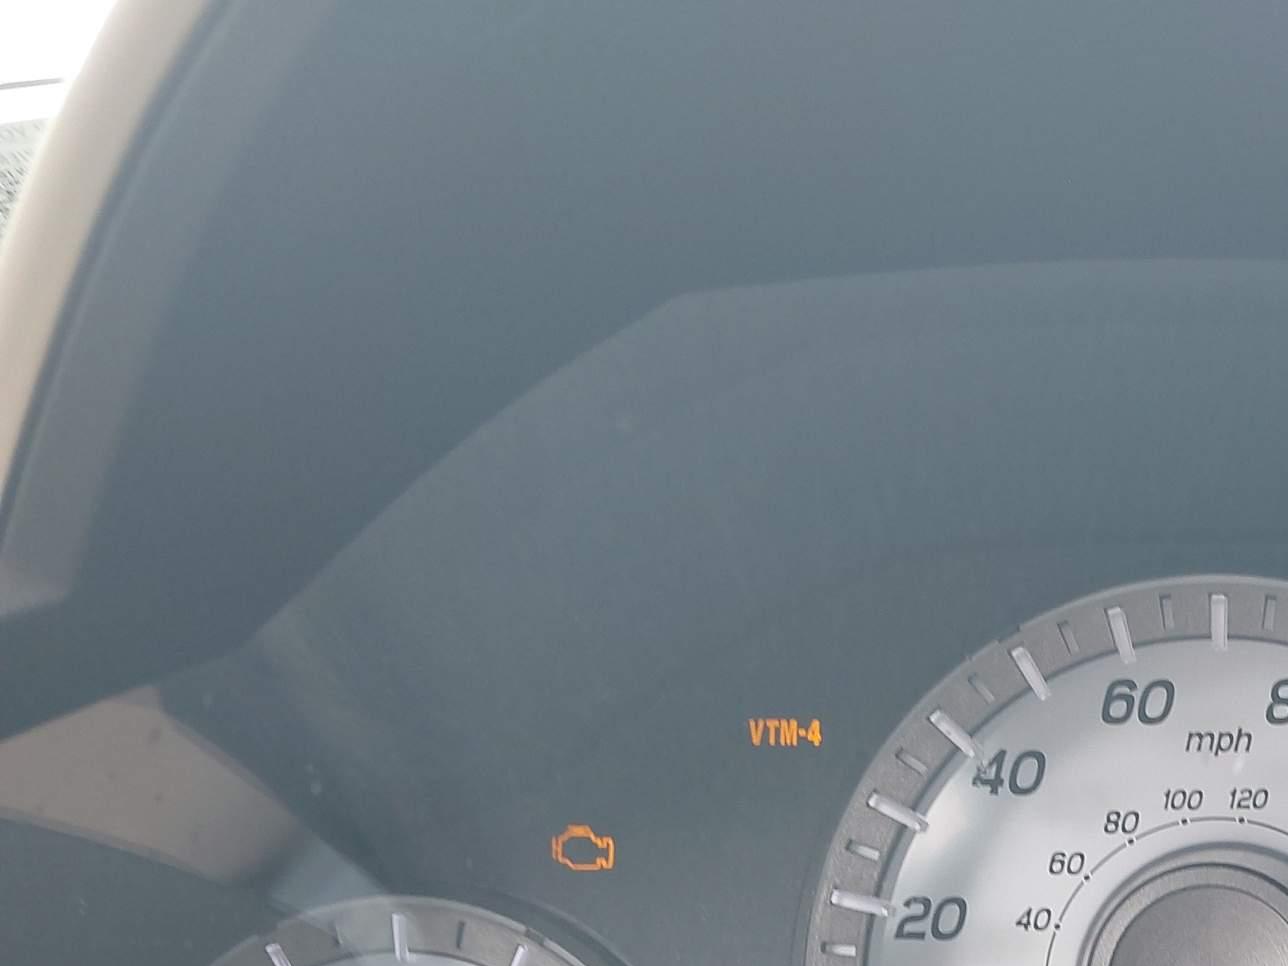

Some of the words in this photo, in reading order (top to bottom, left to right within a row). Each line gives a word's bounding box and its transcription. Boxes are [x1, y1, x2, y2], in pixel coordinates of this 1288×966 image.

[1101, 679, 1175, 726] 60
[748, 717, 823, 747] VTM-4
[1186, 728, 1252, 757] mph
[972, 750, 1046, 797] 40
[1163, 788, 1203, 811] 100
[1229, 788, 1268, 810] 120
[1104, 811, 1140, 834] 80
[1049, 852, 1085, 876] 60
[895, 896, 968, 941] 20
[1016, 908, 1051, 932] 40
